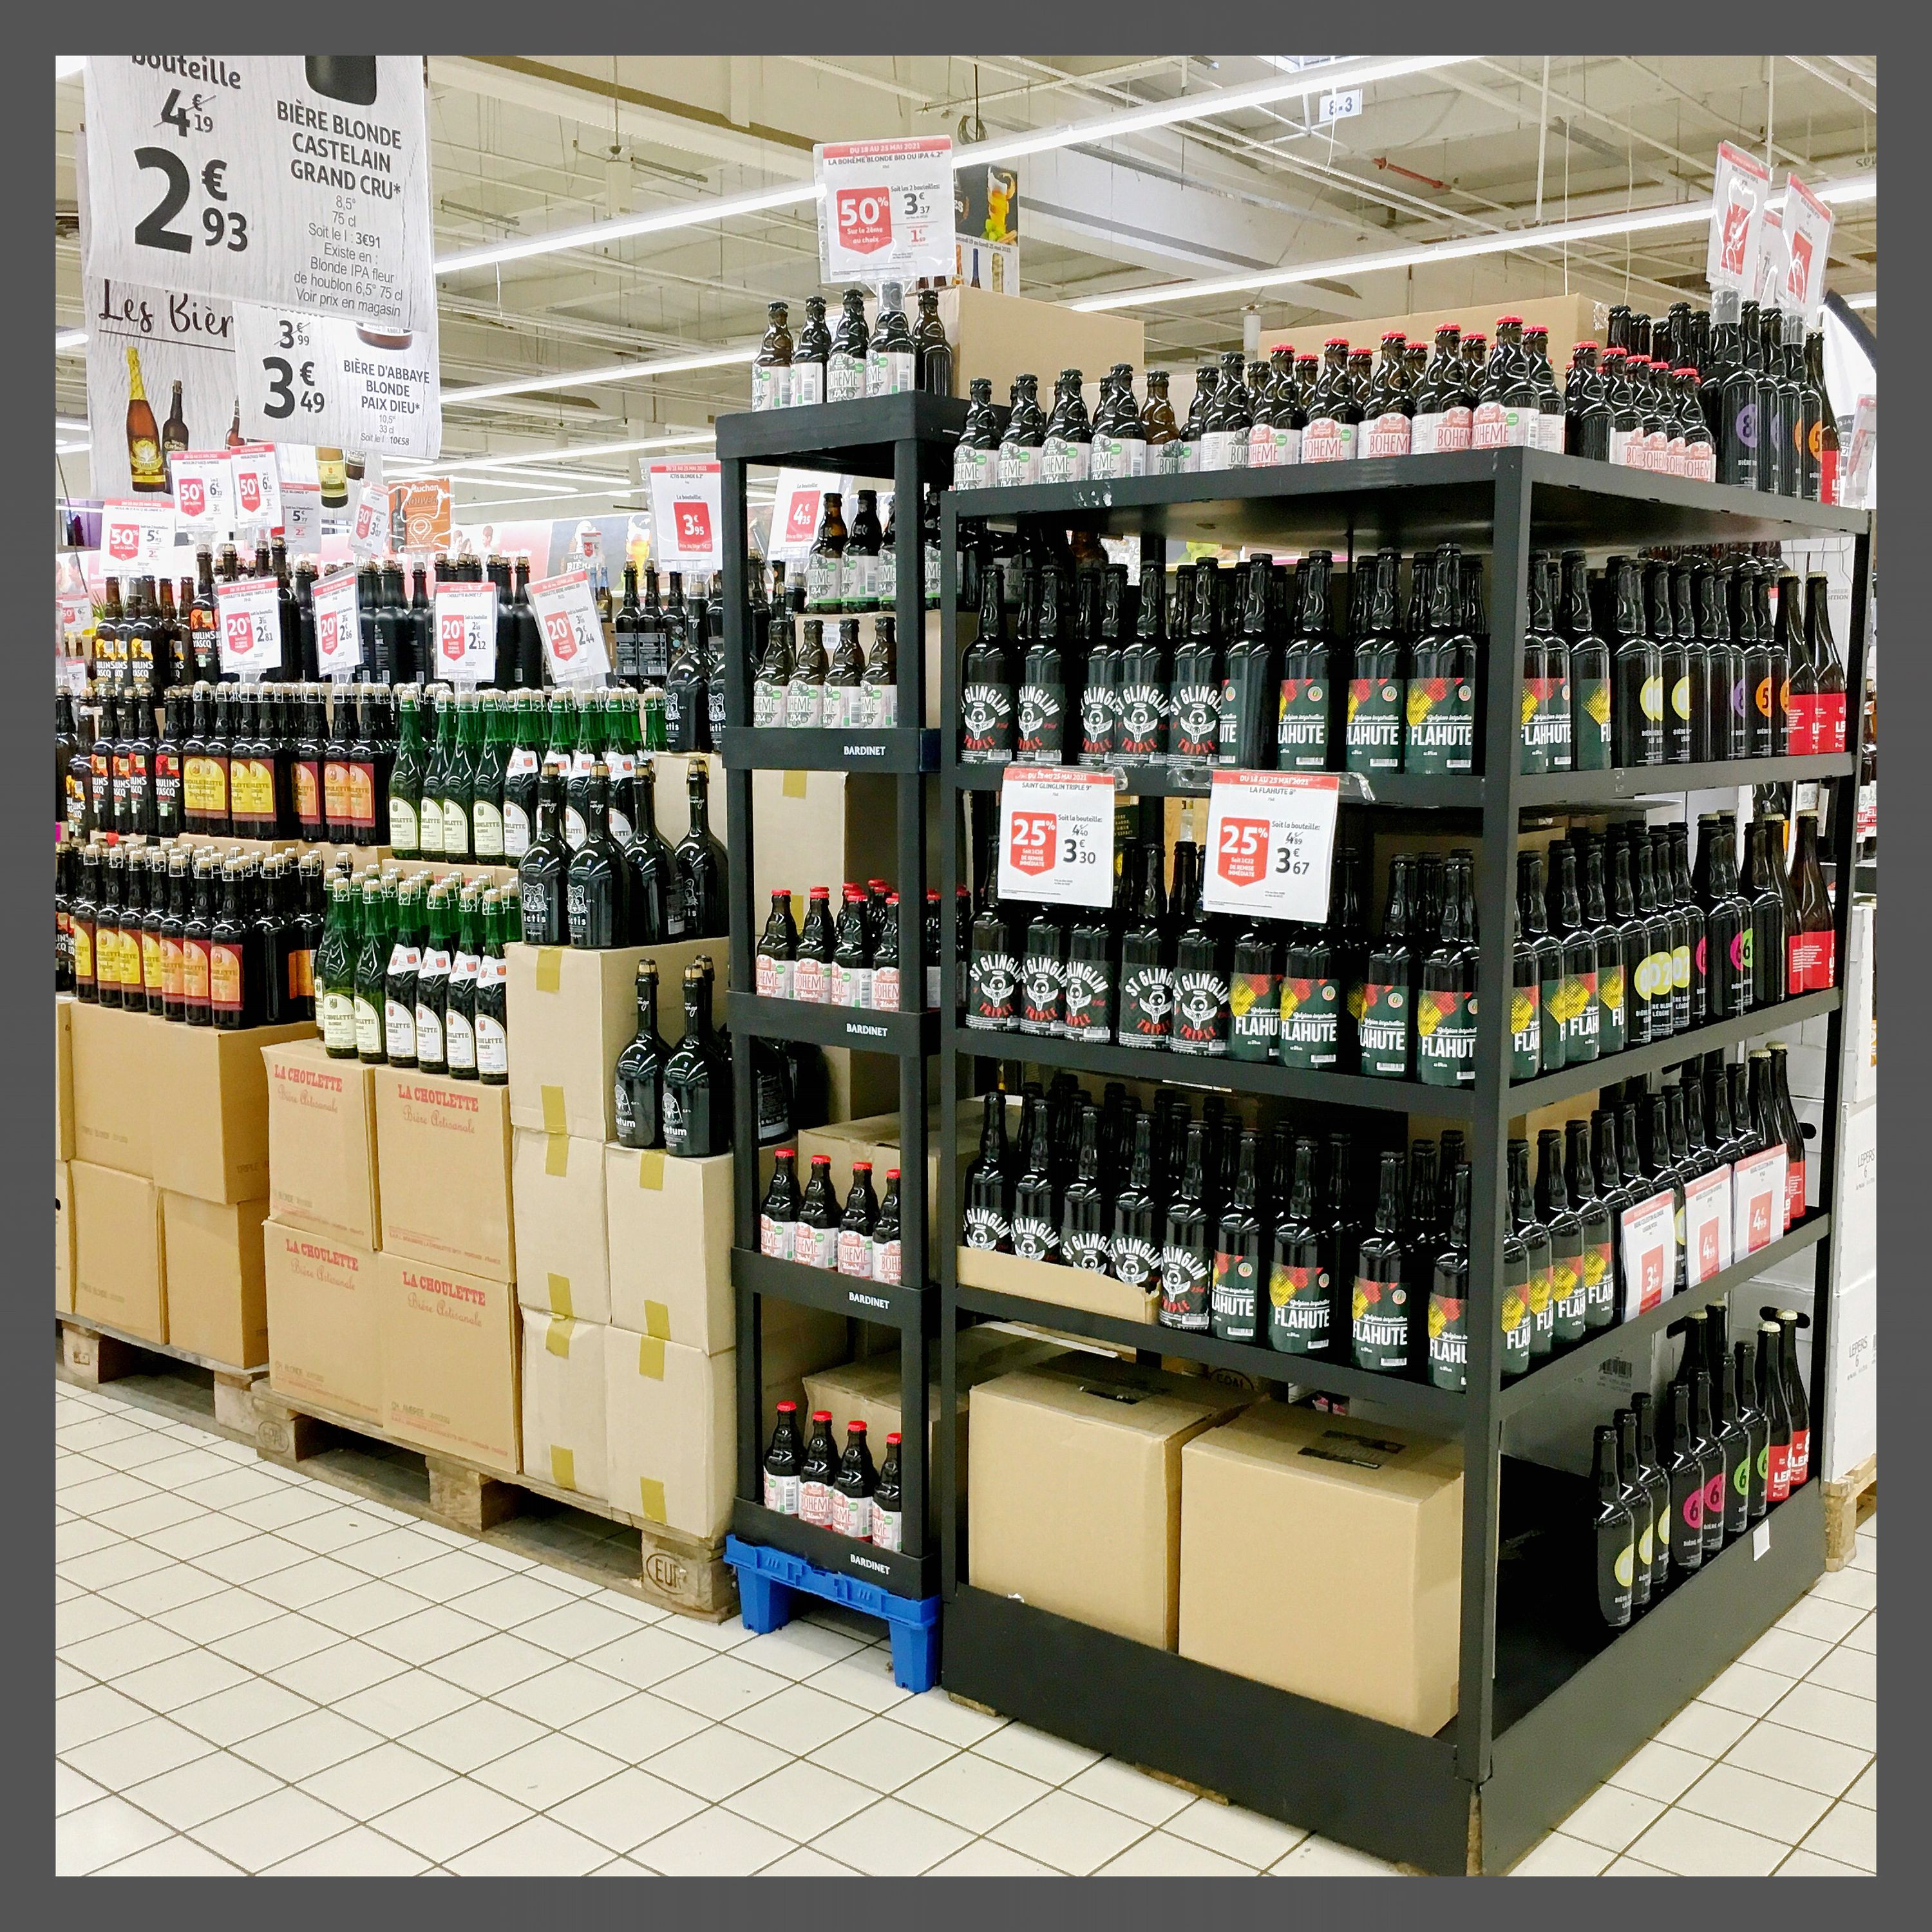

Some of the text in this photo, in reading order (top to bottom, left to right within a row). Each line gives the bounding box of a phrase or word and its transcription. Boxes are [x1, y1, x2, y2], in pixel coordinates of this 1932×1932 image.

[277, 99, 402, 149] BIÈRE BLONDE
[292, 132, 391, 173] CASTELAIN
[838, 155, 866, 165] BOHÈME
[867, 154, 893, 162] BLONDE
[290, 159, 355, 191] GRAND
[336, 195, 355, 211] 8,5°
[332, 211, 355, 227] 75 cl
[308, 222, 380, 249] Soit le 3€91
[324, 243, 372, 263] Existe en
[310, 256, 394, 283] Blonde IPA fleur
[294, 271, 402, 301] de houblon 6,5° 75 cl
[99, 279, 153, 333] Les
[296, 287, 401, 317] Voir prix en magasin
[344, 358, 430, 384] BIÈRE D'ABBAYE
[366, 380, 410, 397] BLONDE
[361, 396, 387, 411] PAIX
[1170, 696, 1182, 715] ST
[1410, 725, 1472, 746] FLAHUTE
[844, 746, 886, 756] BARDINET
[1259, 786, 1288, 795] FLAHUTE
[524, 913, 546, 923] ictis
[969, 963, 983, 981] ST
[846, 1023, 888, 1037] BARDINET
[1281, 1020, 1337, 1042] FLAHUTE
[274, 1065, 343, 1093] LA CHOULETTE
[398, 1084, 479, 1113] LA CHOULETTE
[285, 1239, 359, 1272] LA CHOULETTE
[402, 1271, 486, 1307] LA CHOULETTE
[849, 1291, 890, 1309] BARDINET
[1274, 1307, 1330, 1329] FLAHUTE
[1352, 1319, 1408, 1346] FLAHUTE
[1848, 1336, 1868, 1358] LEPERS
[1689, 1499, 1698, 1521] 6
[849, 1553, 891, 1575] BARDINET
